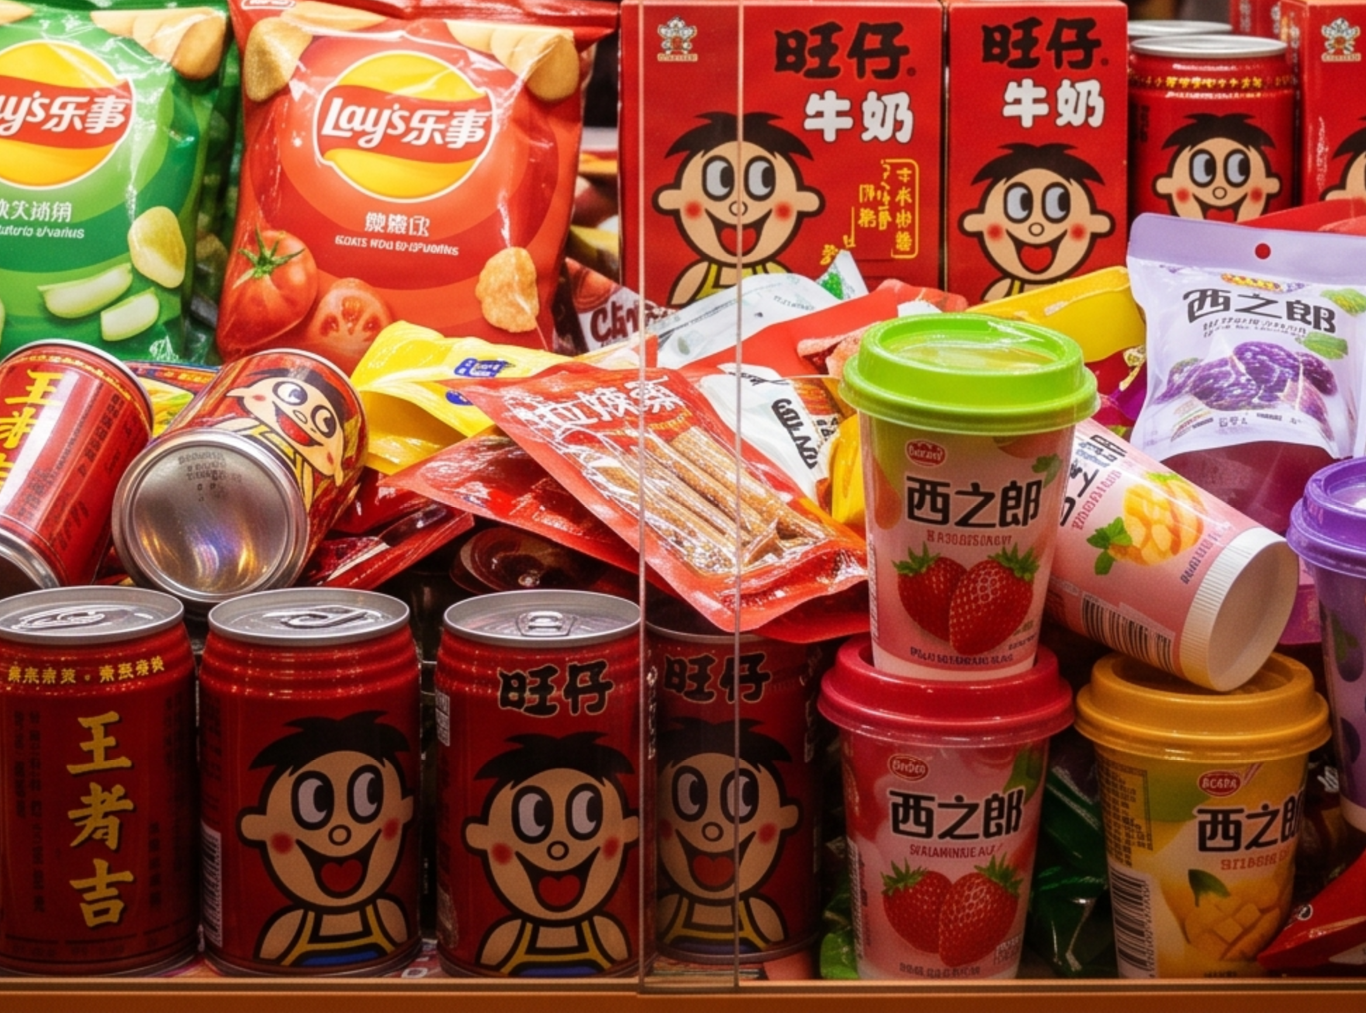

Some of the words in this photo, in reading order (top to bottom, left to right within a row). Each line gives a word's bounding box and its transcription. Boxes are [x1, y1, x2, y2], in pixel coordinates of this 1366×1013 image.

[774, 21, 910, 80] 旺仔
[981, 17, 1102, 70] 旺仔
[803, 90, 914, 144] 牛奶
[1002, 78, 1105, 128] 牛奶
[1185, 288, 1336, 334] 西之郎
[905, 475, 1043, 529] 西之郎
[66, 710, 134, 928] 王者吉
[889, 787, 1025, 840] 西之郎
